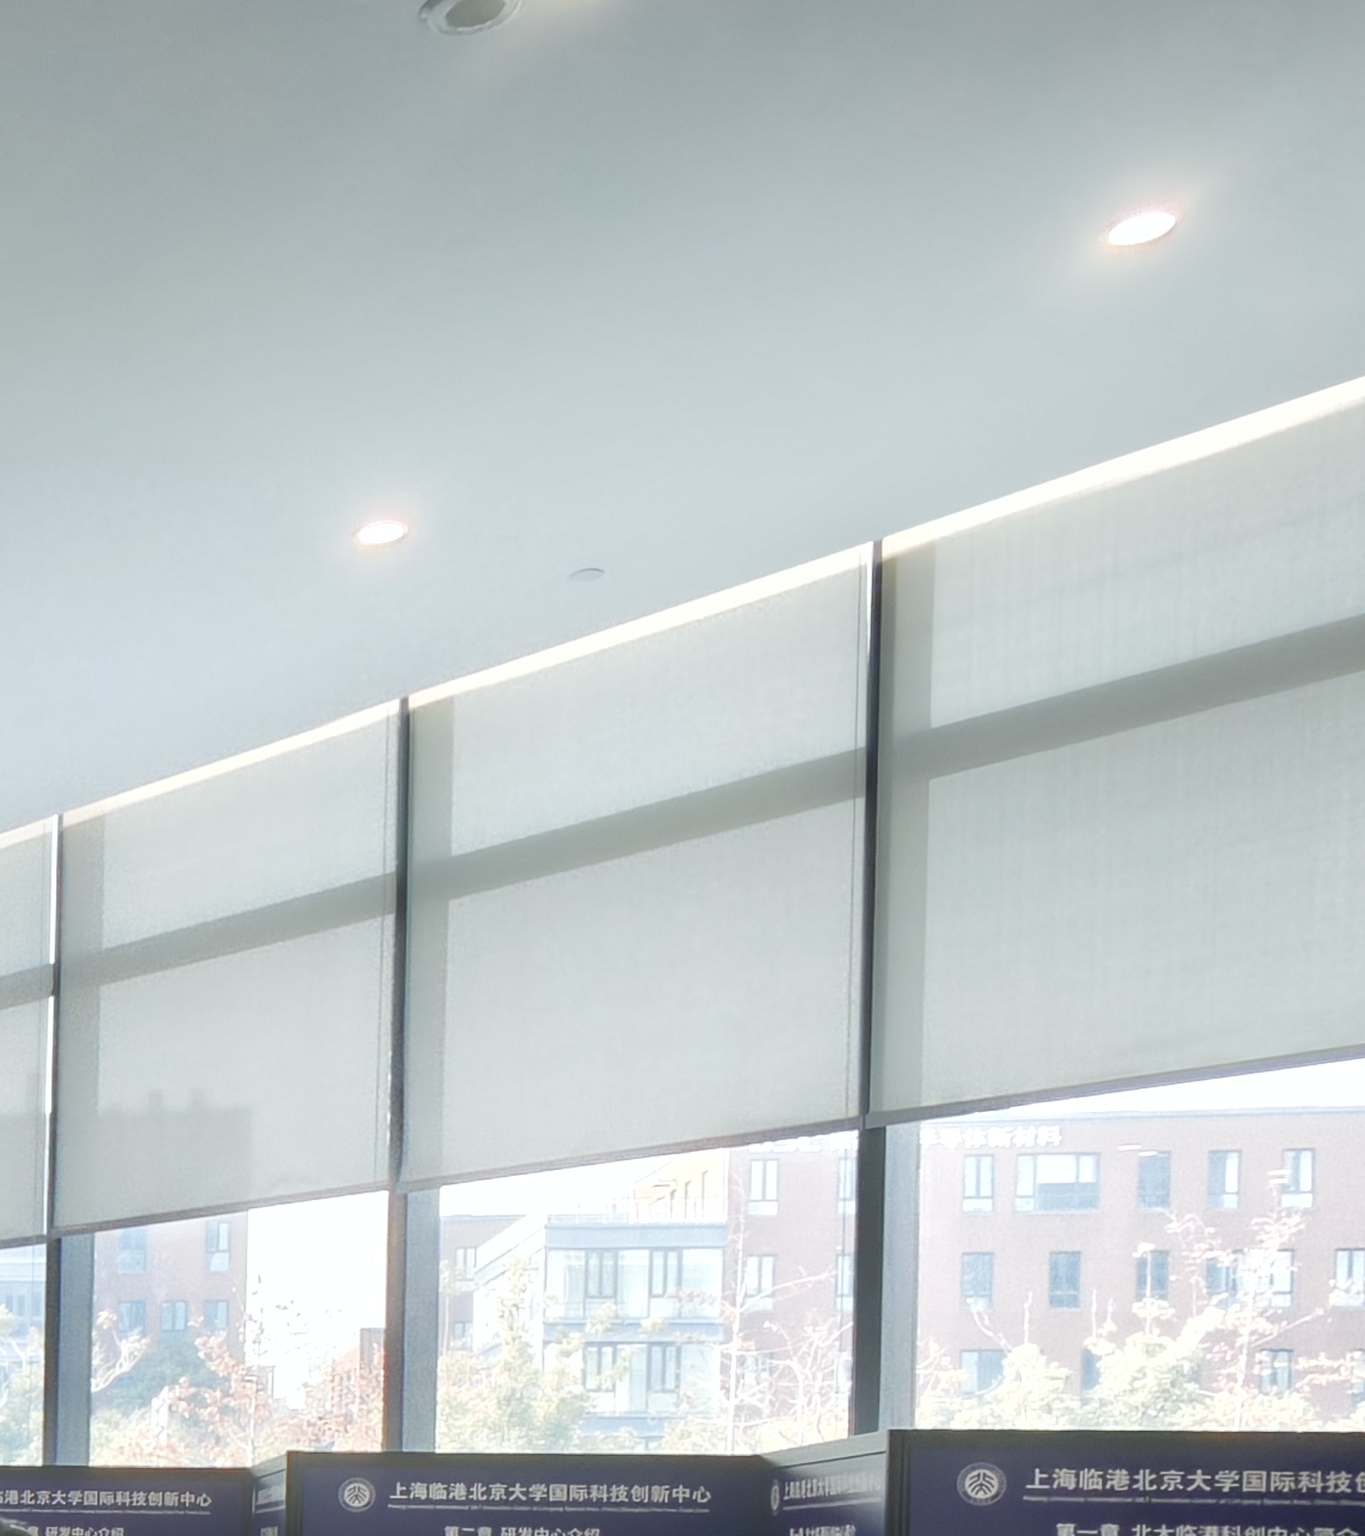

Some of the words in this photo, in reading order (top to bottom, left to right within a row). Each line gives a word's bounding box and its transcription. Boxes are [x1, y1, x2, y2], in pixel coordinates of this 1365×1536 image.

[390, 1482, 712, 1503] 上海临港北京大学国际科技创新中心
